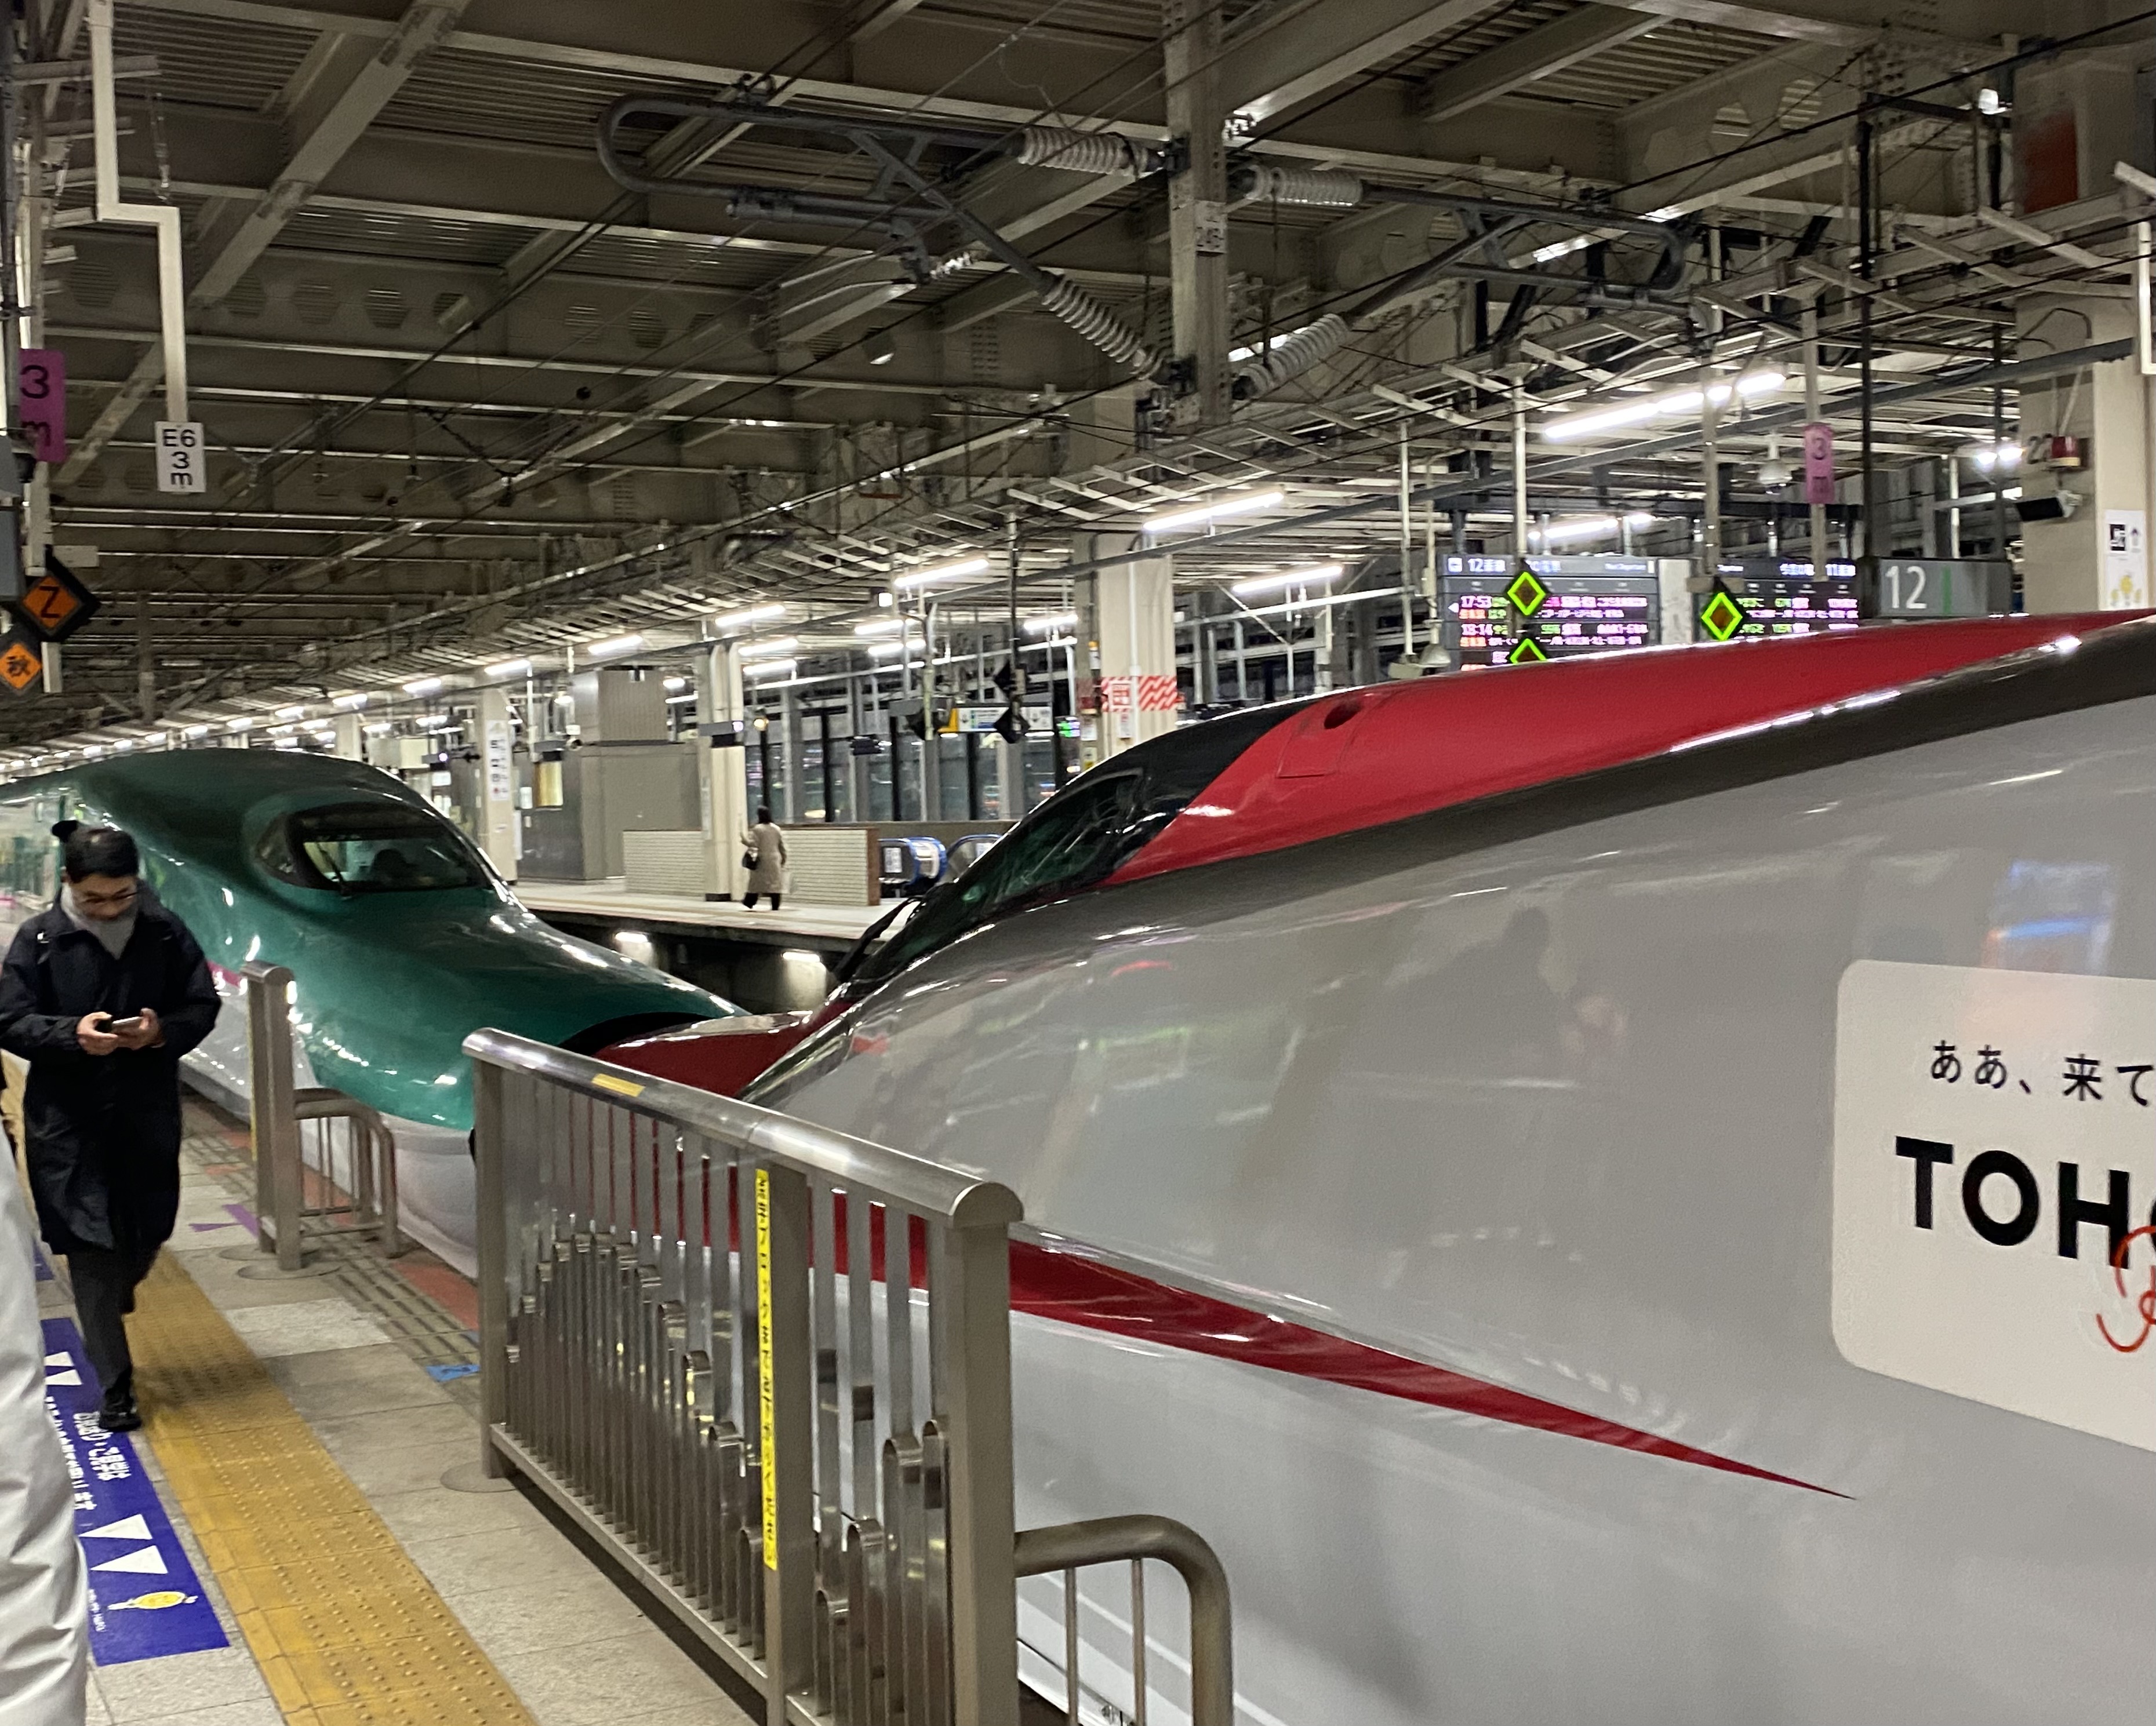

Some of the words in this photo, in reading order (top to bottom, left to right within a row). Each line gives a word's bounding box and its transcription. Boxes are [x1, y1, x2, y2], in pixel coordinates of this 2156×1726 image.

[21, 365, 50, 399] 3
[163, 429, 196, 447] E6
[172, 451, 190, 469] 3
[170, 472, 193, 486] m
[39, 585, 60, 618] Z
[1885, 565, 1928, 610] 12
[1930, 1040, 2154, 1106] ああ、来て
[1895, 1135, 2156, 1269] TOH
